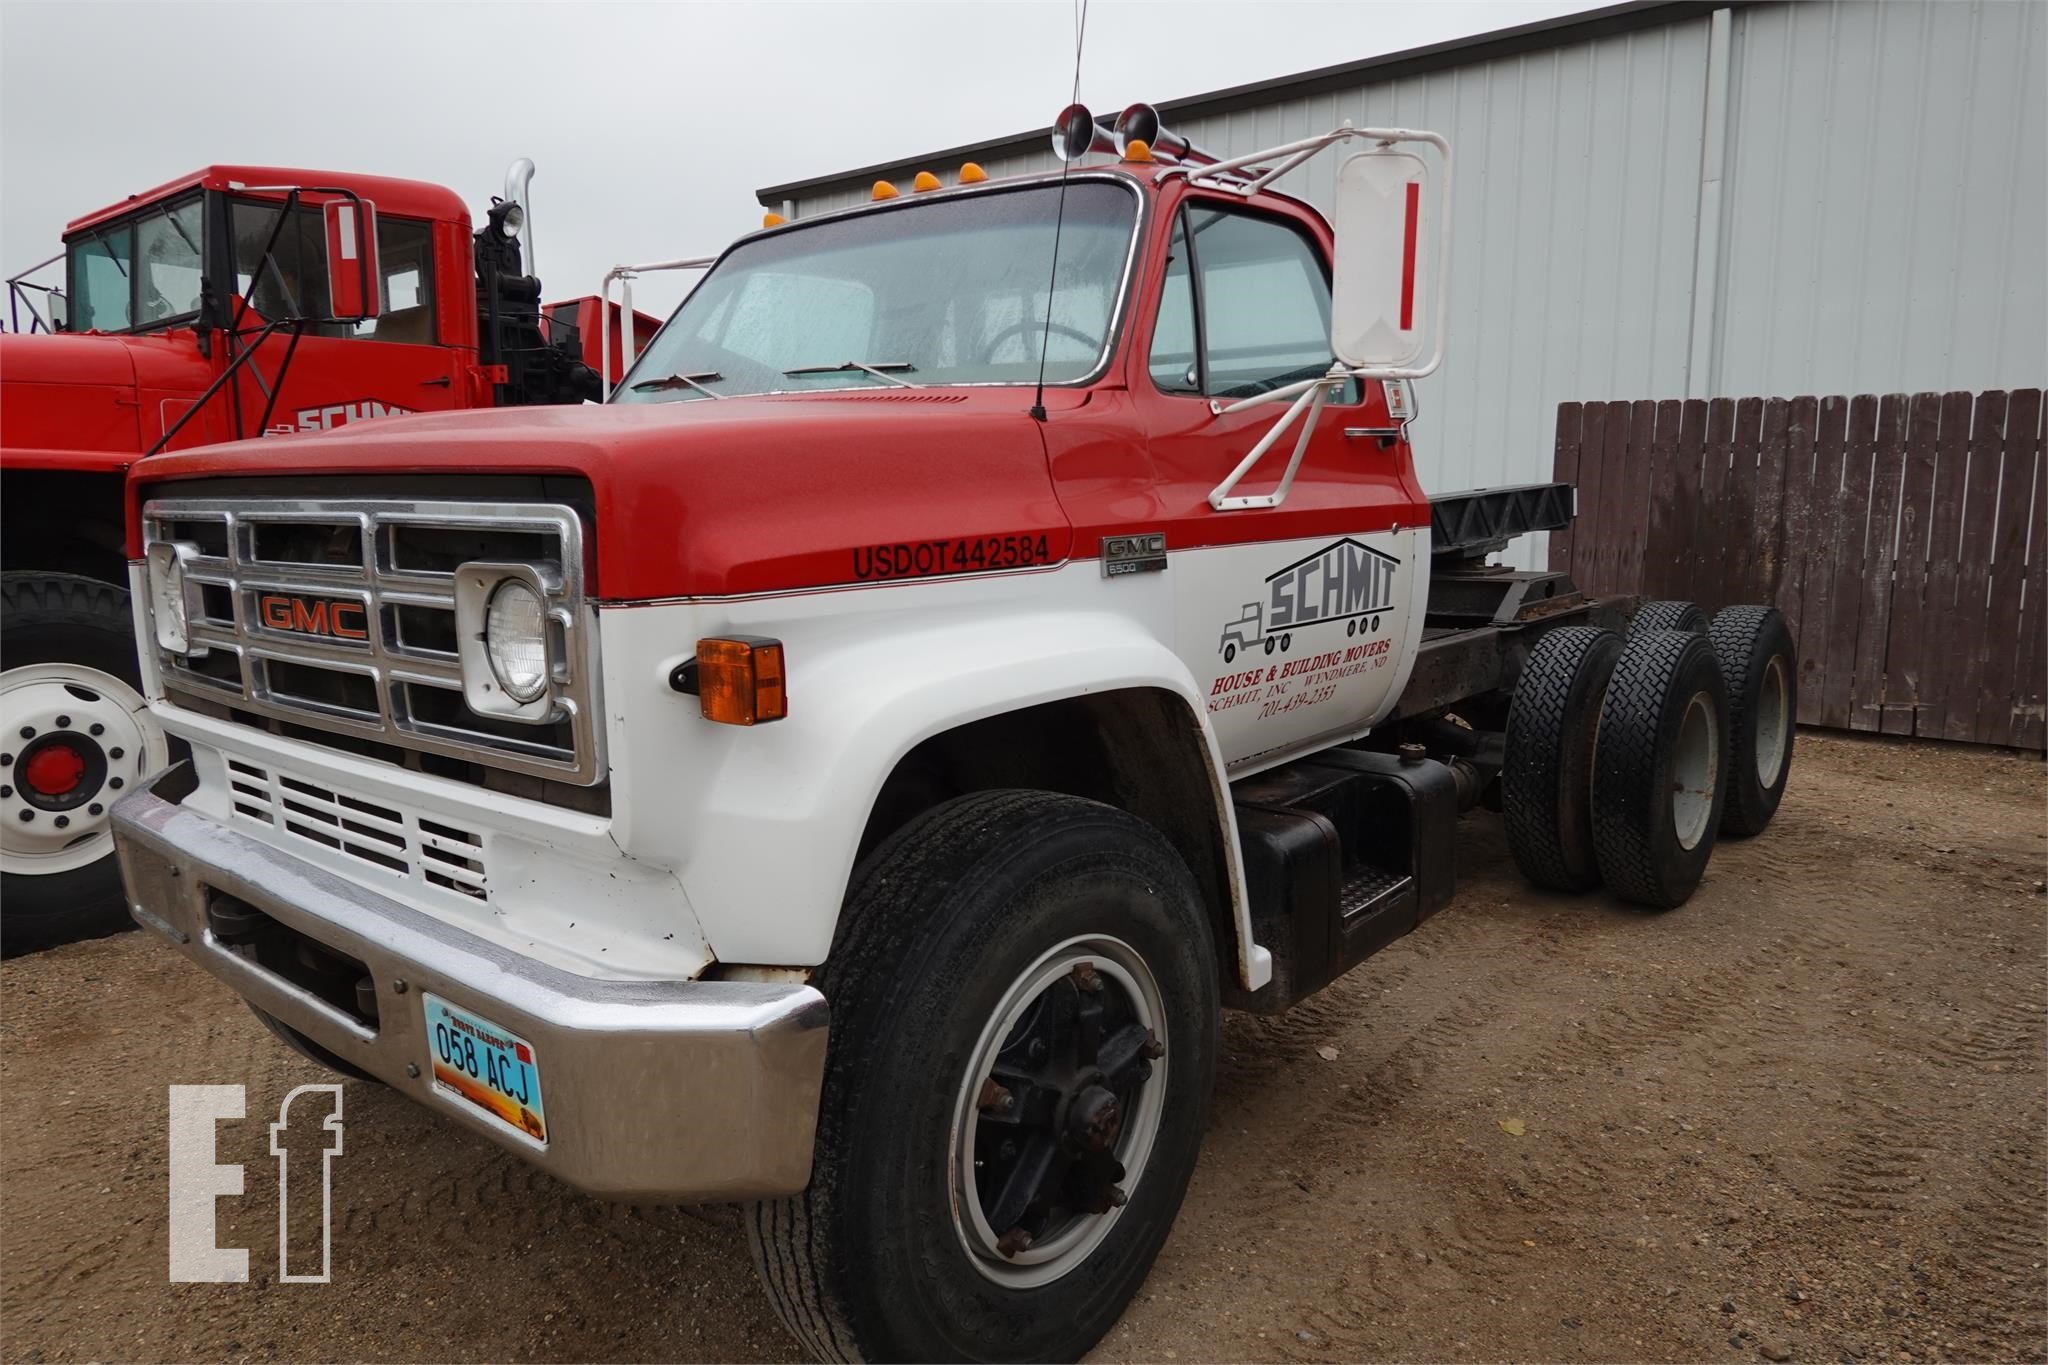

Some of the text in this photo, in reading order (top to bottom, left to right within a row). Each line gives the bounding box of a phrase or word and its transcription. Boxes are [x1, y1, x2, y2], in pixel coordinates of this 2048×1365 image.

[1108, 536, 1163, 555] GMC
[1109, 563, 1136, 574] 6500
[1270, 544, 1396, 627] SCHMIT
[262, 596, 367, 638] GMC
[1207, 656, 1388, 714] SCHMIT, INC WYNDMERE, ND
[1210, 638, 1391, 696] HOUSE & BUILDING MOVERS
[1257, 685, 1337, 721] 701-439-2353
[436, 1022, 529, 1106] 058 ACJ
